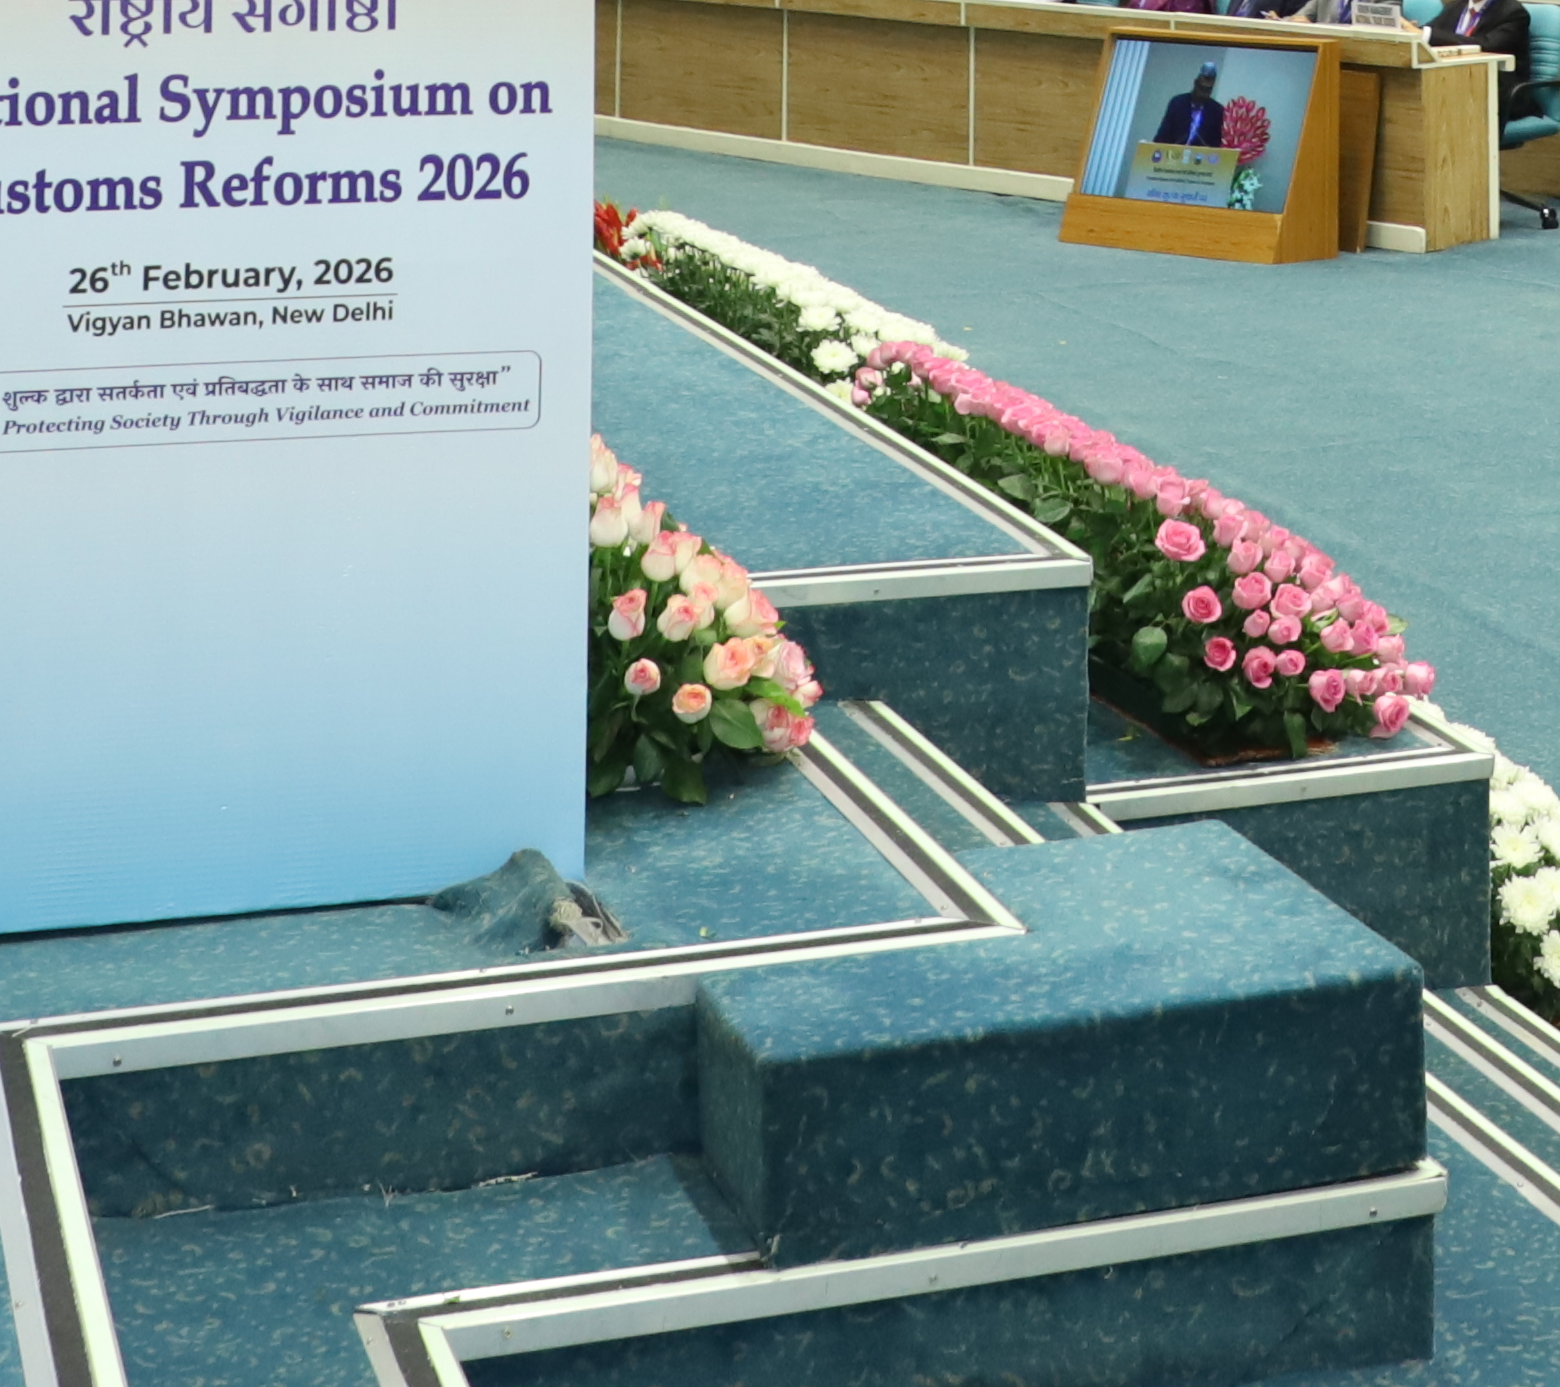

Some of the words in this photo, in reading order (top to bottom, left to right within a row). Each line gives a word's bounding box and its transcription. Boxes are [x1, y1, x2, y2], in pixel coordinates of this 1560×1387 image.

[158, 69, 472, 137] Symposium
[488, 81, 552, 115] on
[179, 156, 402, 209] Reforms
[417, 153, 530, 201] 2026
[142, 263, 303, 293] February,
[313, 257, 394, 285] 2026
[67, 312, 151, 337] Vigyan
[159, 307, 264, 329] Bhawan,
[272, 305, 324, 324] New
[332, 300, 393, 322] Delhi
[3, 390, 50, 411] शुल्क
[54, 387, 93, 404] द्वारा
[97, 380, 166, 402] सतर्कता
[171, 378, 200, 400] एवं
[204, 376, 287, 397] प्रतिबद्धता
[292, 373, 311, 393] के
[316, 375, 355, 391] साथ
[359, 374, 415, 390] समाज
[418, 368, 443, 388] की
[2, 416, 105, 436] Protecting
[109, 413, 182, 430] Society
[187, 407, 270, 428] Through
[275, 401, 365, 426] Vigilance
[368, 401, 405, 418] and
[409, 398, 531, 416] Commitment
